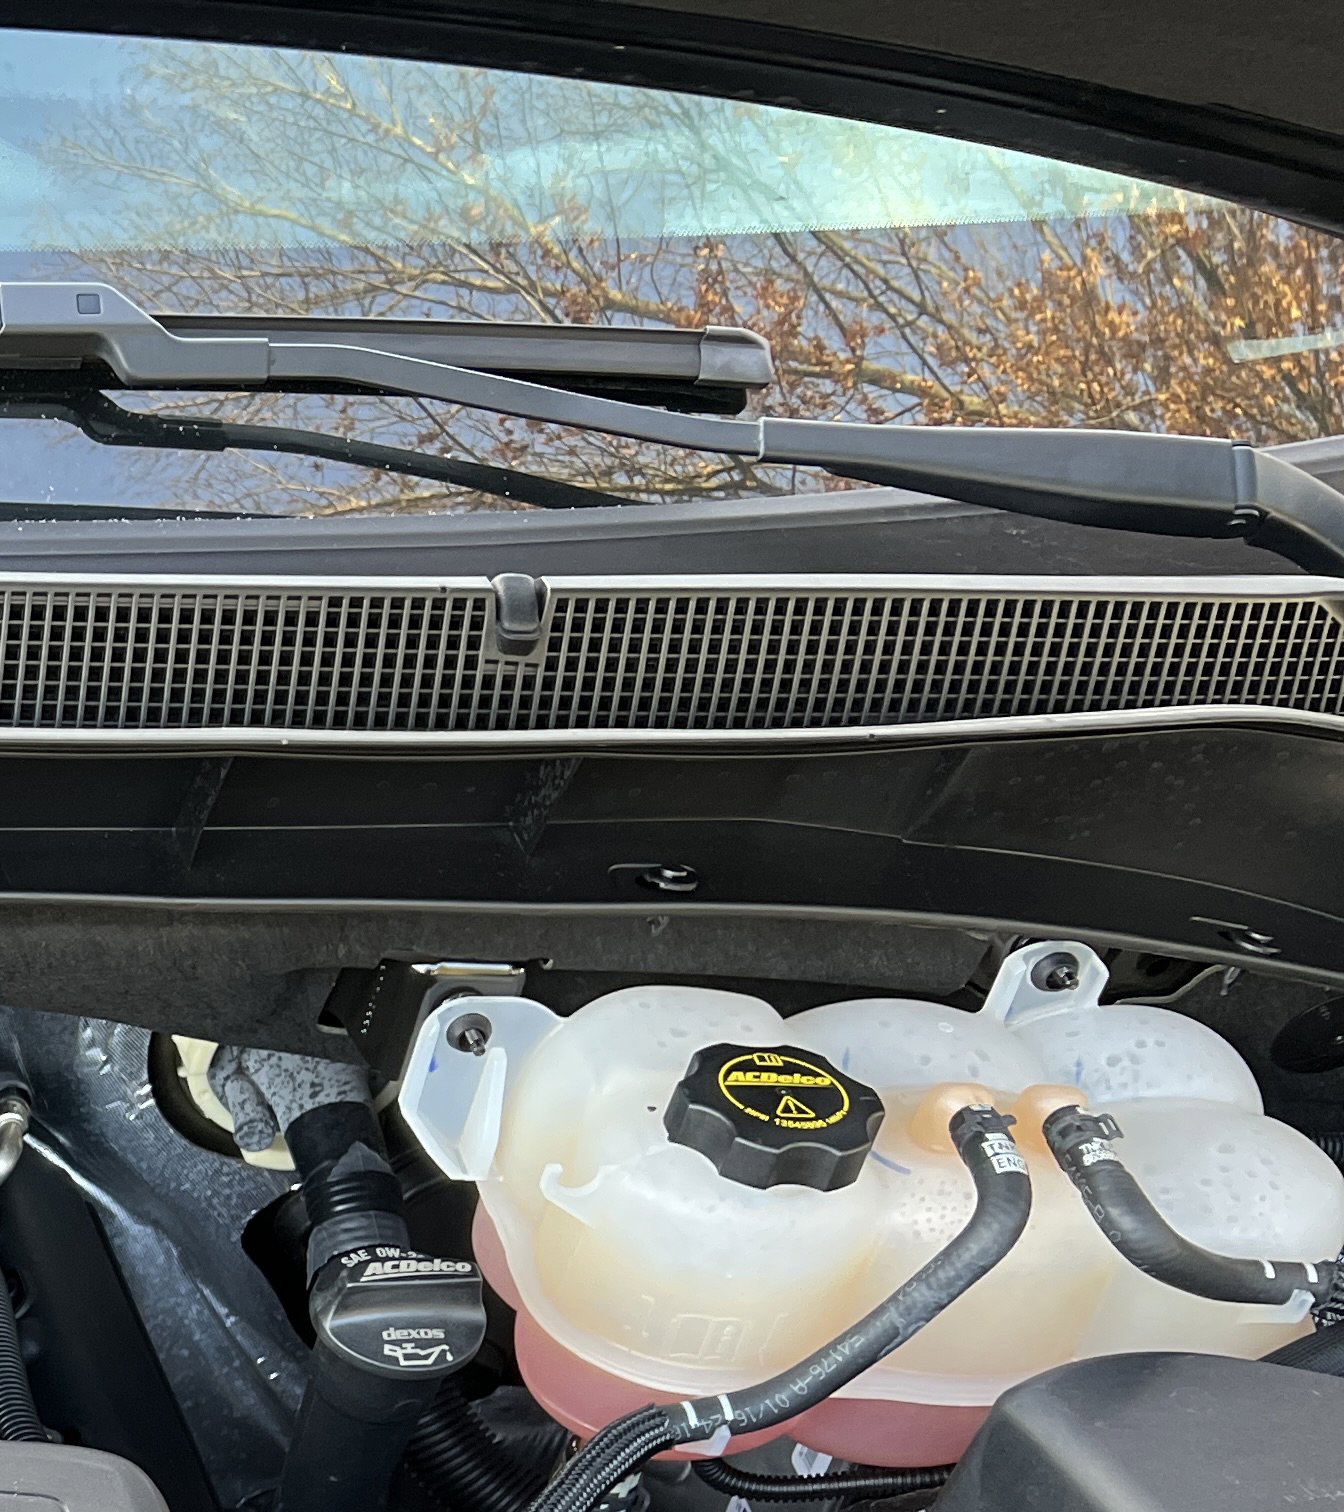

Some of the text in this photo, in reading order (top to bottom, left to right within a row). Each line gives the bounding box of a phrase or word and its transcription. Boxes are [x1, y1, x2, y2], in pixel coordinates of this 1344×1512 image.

[726, 1071, 832, 1086] ACDelco
[341, 1249, 371, 1268] SAE
[362, 1258, 473, 1276] ACDelco
[381, 1326, 446, 1341] dexos
